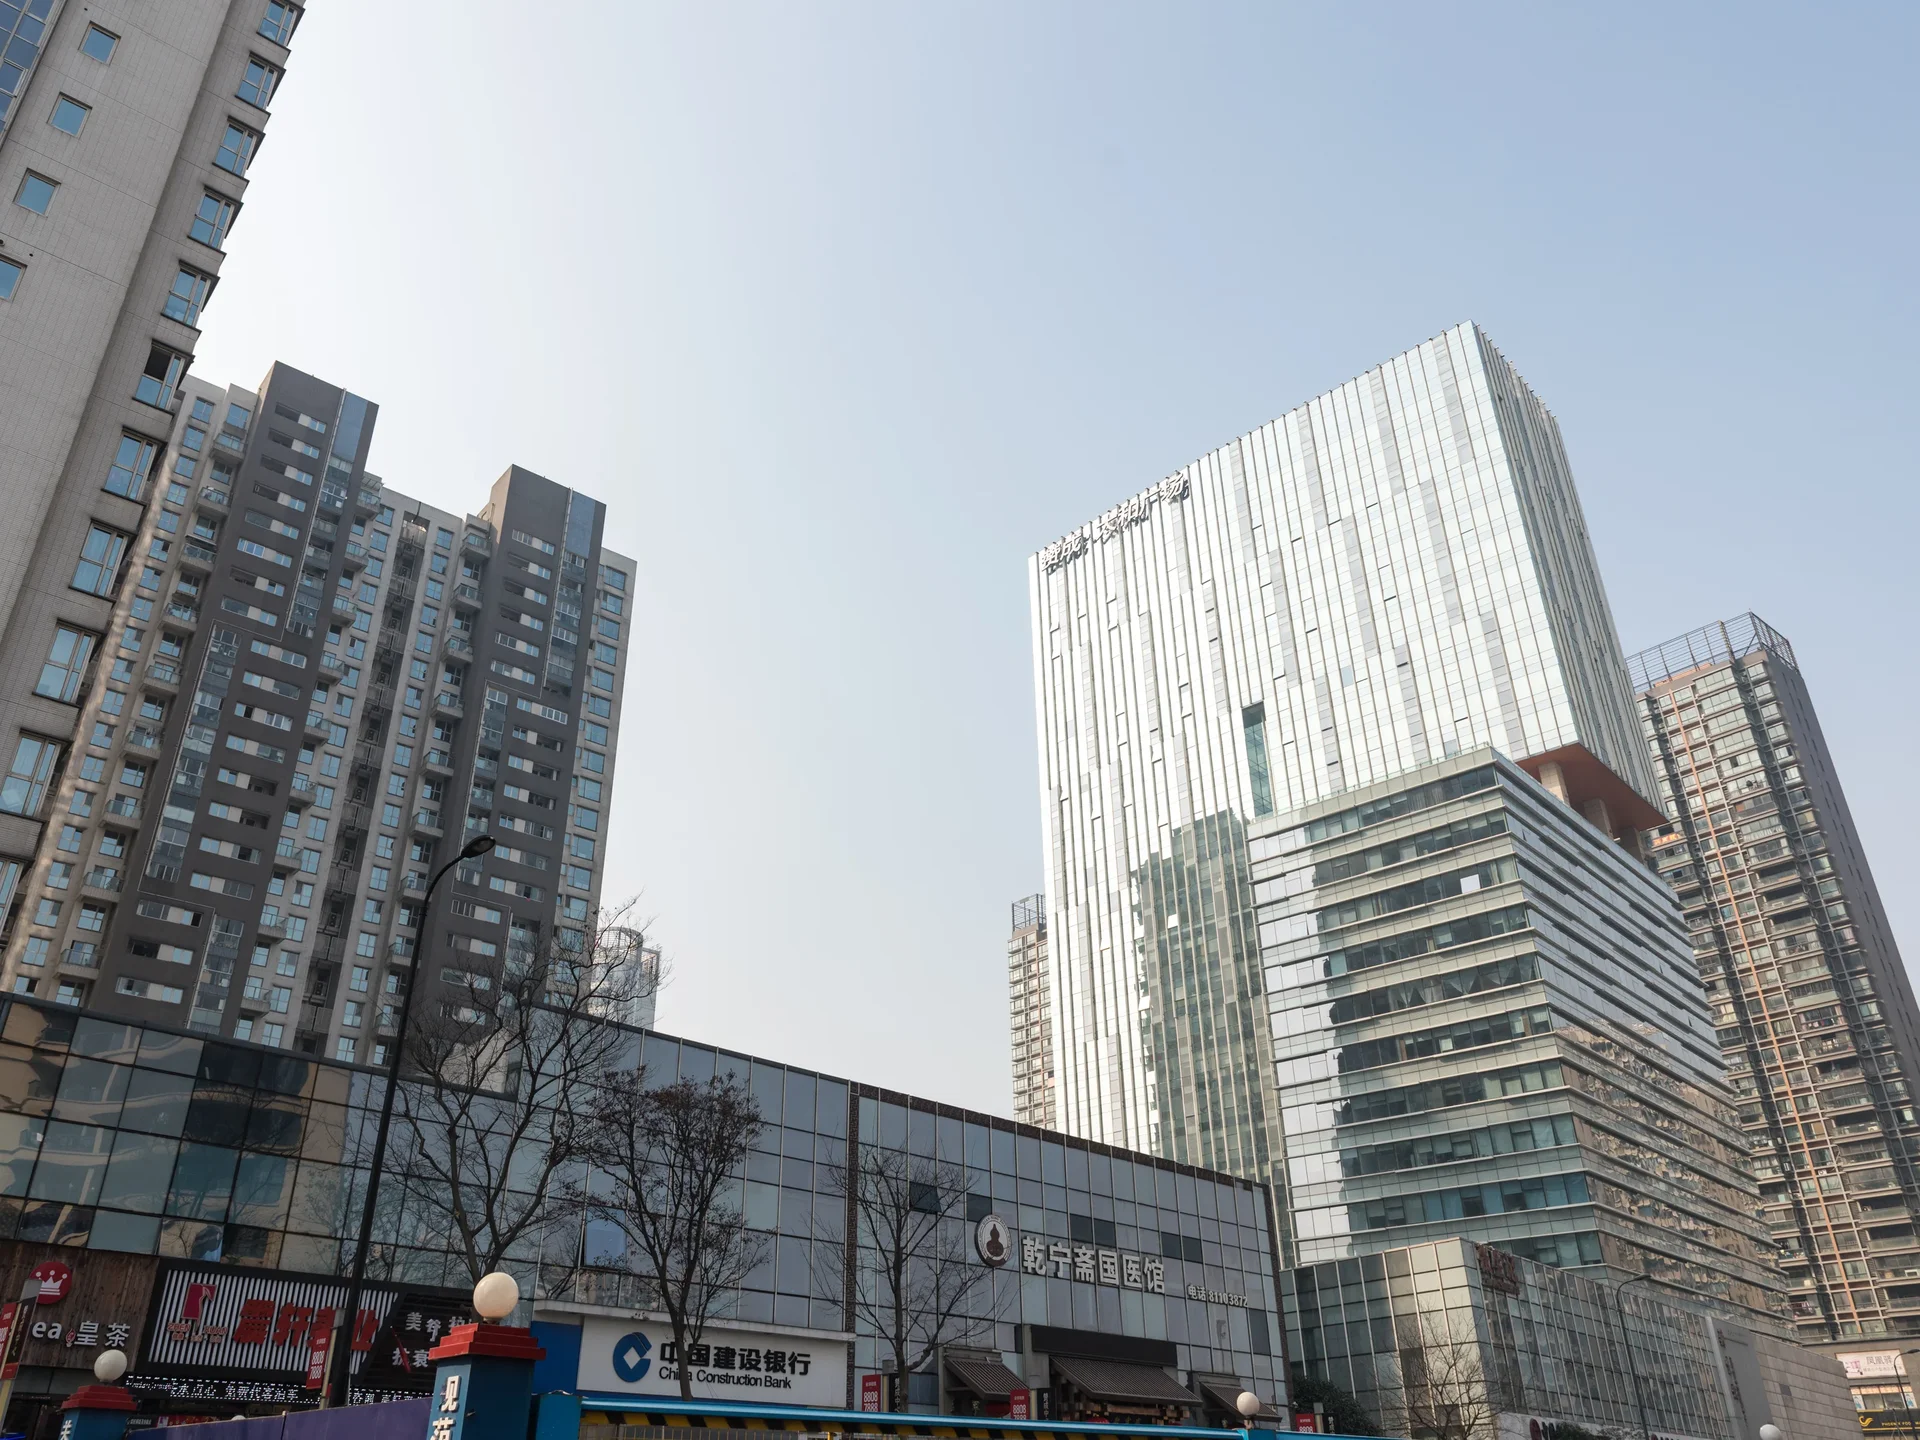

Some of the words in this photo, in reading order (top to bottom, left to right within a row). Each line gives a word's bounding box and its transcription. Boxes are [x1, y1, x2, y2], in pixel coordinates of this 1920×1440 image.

[1021, 1236, 1165, 1294] 乾宁斋国医馆
[1188, 1285, 1206, 1302] 电话
[1208, 1289, 1248, 1308] 81103872
[74, 1320, 131, 1347] 皇茶
[660, 1341, 811, 1376] 中国建设银行
[659, 1366, 692, 1382] Chia
[697, 1369, 763, 1388] Construction
[764, 1376, 792, 1389] Bank
[863, 1391, 878, 1402] 8808
[1013, 1404, 1026, 1414] 8808
